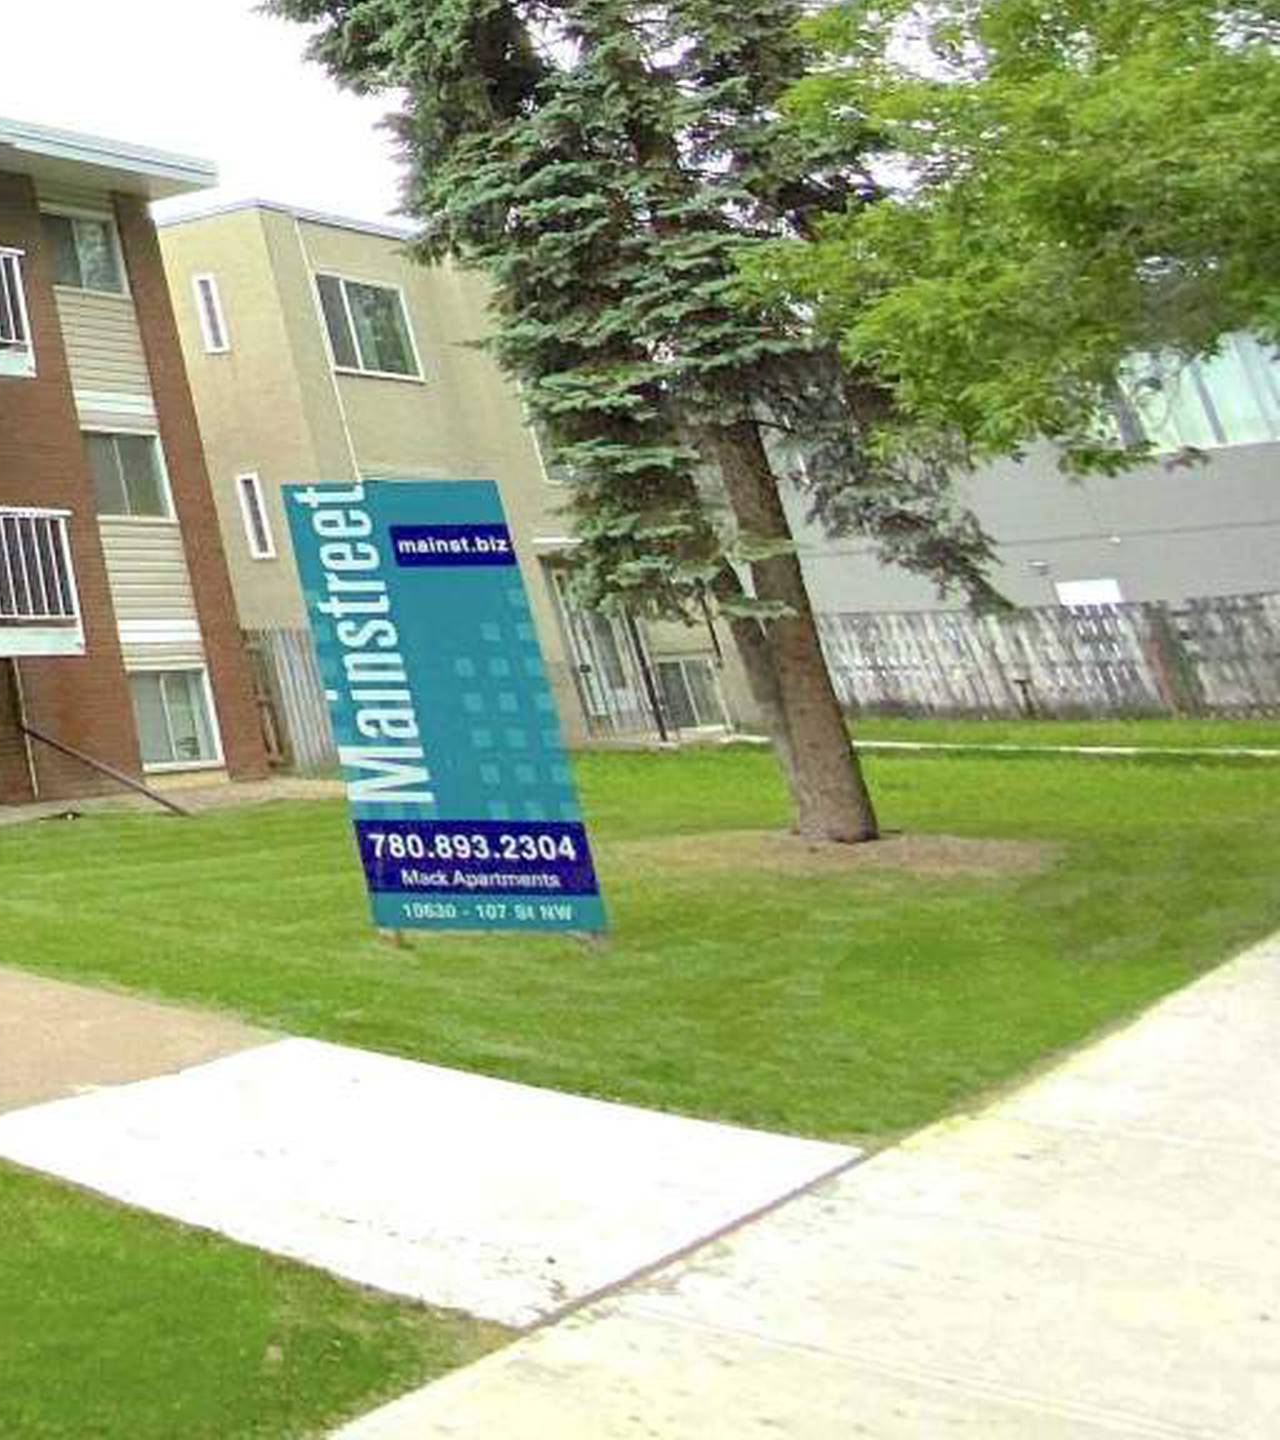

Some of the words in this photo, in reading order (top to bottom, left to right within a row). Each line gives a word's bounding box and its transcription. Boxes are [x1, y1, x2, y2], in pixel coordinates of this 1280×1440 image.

[398, 535, 510, 554] mainst.biz
[293, 483, 435, 802] Mainstreet
[368, 833, 576, 860] 780.893.2304
[401, 869, 448, 886] Mack
[453, 870, 561, 888] Apartments
[475, 903, 506, 919] 107
[540, 903, 572, 920] NW
